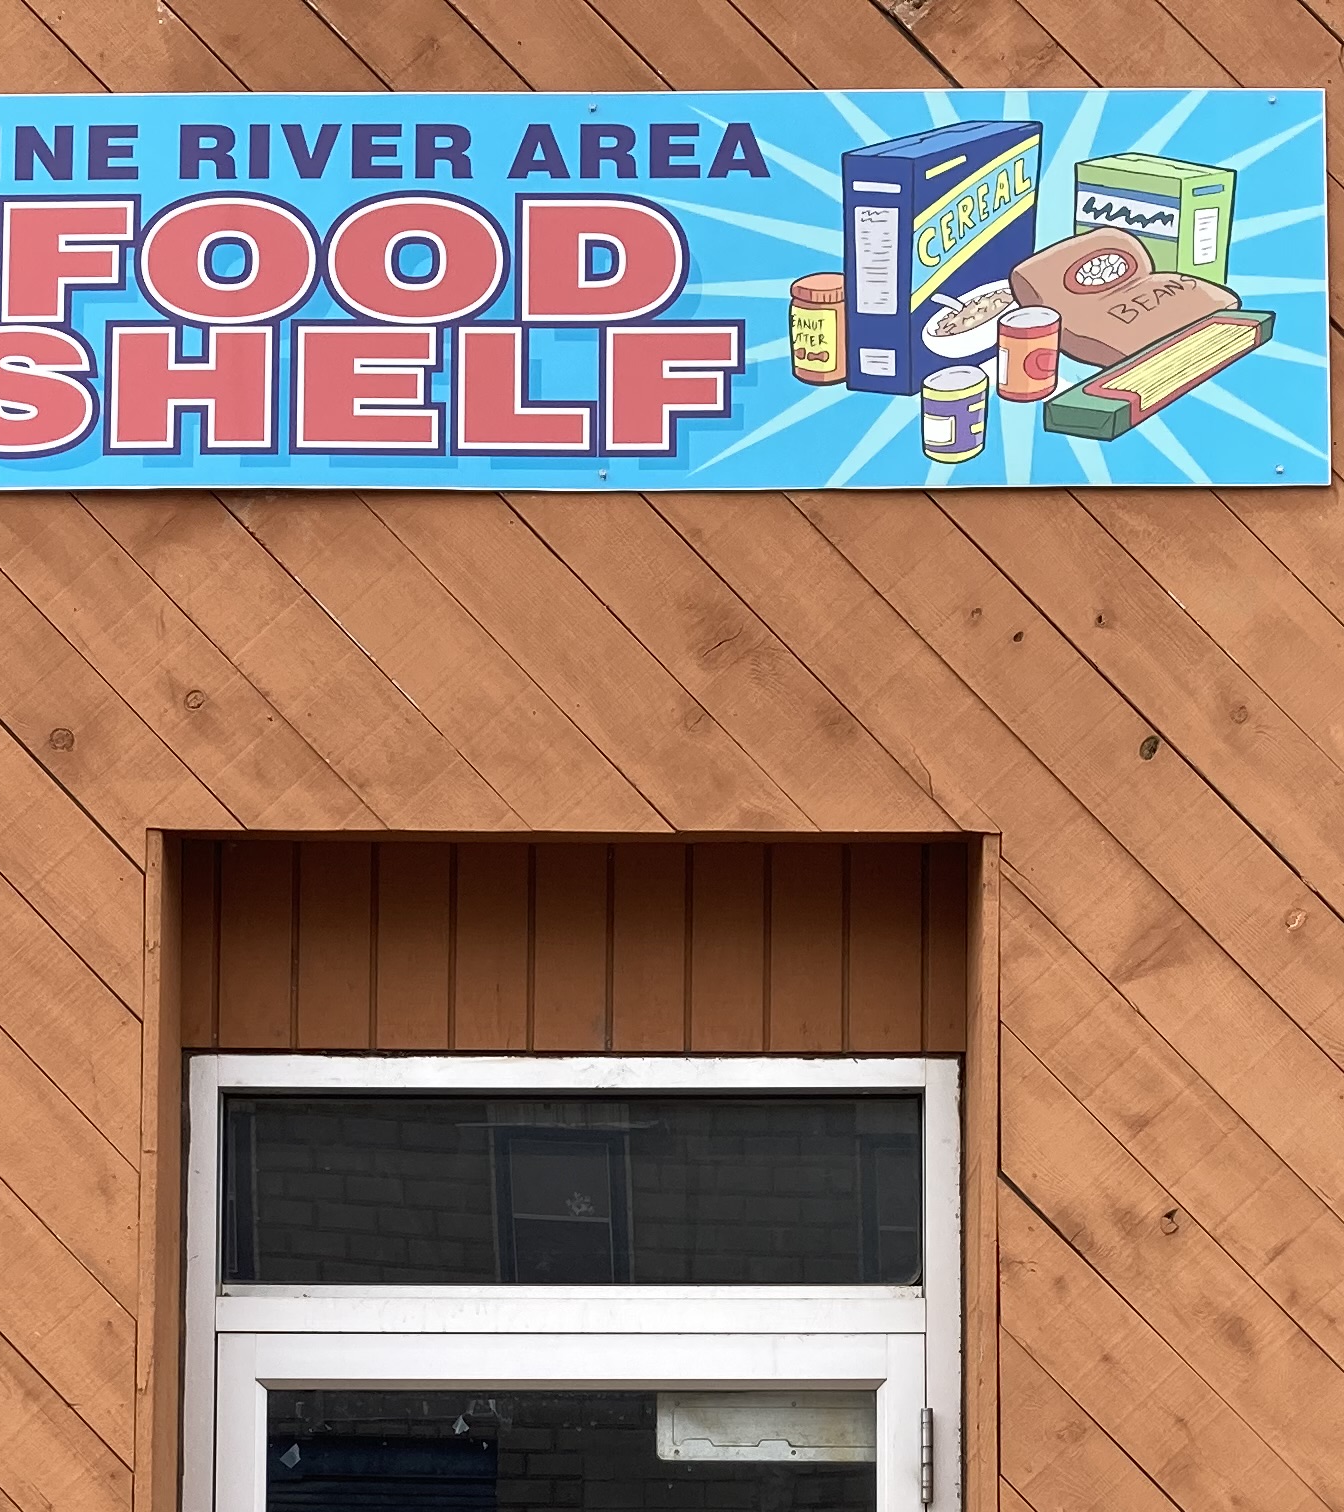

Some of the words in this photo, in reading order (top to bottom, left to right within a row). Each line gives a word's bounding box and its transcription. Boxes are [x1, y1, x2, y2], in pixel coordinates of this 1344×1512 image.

[178, 122, 474, 180] RIVER
[507, 121, 771, 179] AREA
[917, 158, 1033, 268] CEREAL
[1107, 275, 1199, 325] BEANS
